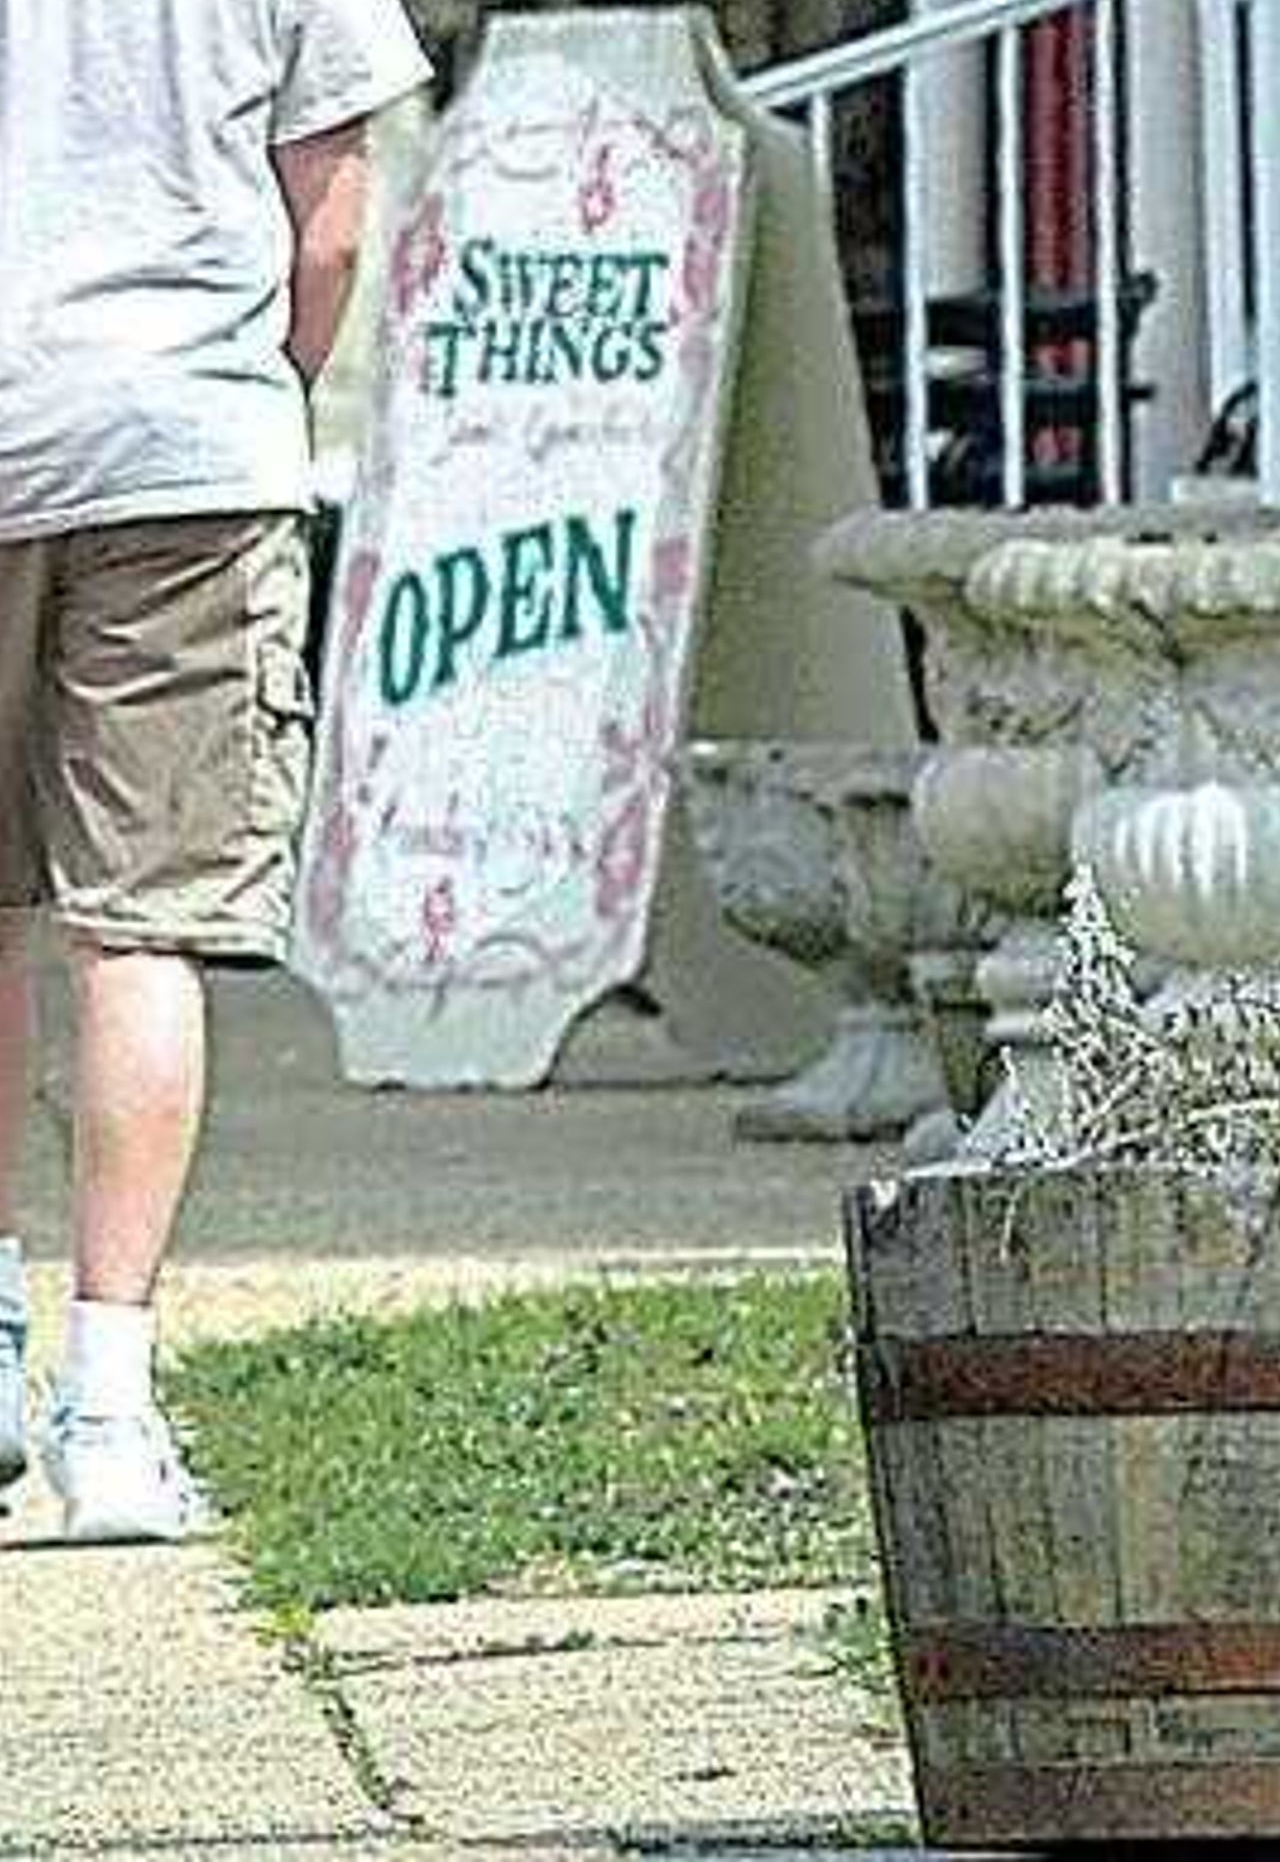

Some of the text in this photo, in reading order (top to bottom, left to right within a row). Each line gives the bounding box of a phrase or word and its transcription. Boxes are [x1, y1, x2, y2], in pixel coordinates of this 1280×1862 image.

[453, 238, 669, 320] SWEET
[423, 320, 669, 398] THINGS
[381, 507, 635, 706] OPEN
